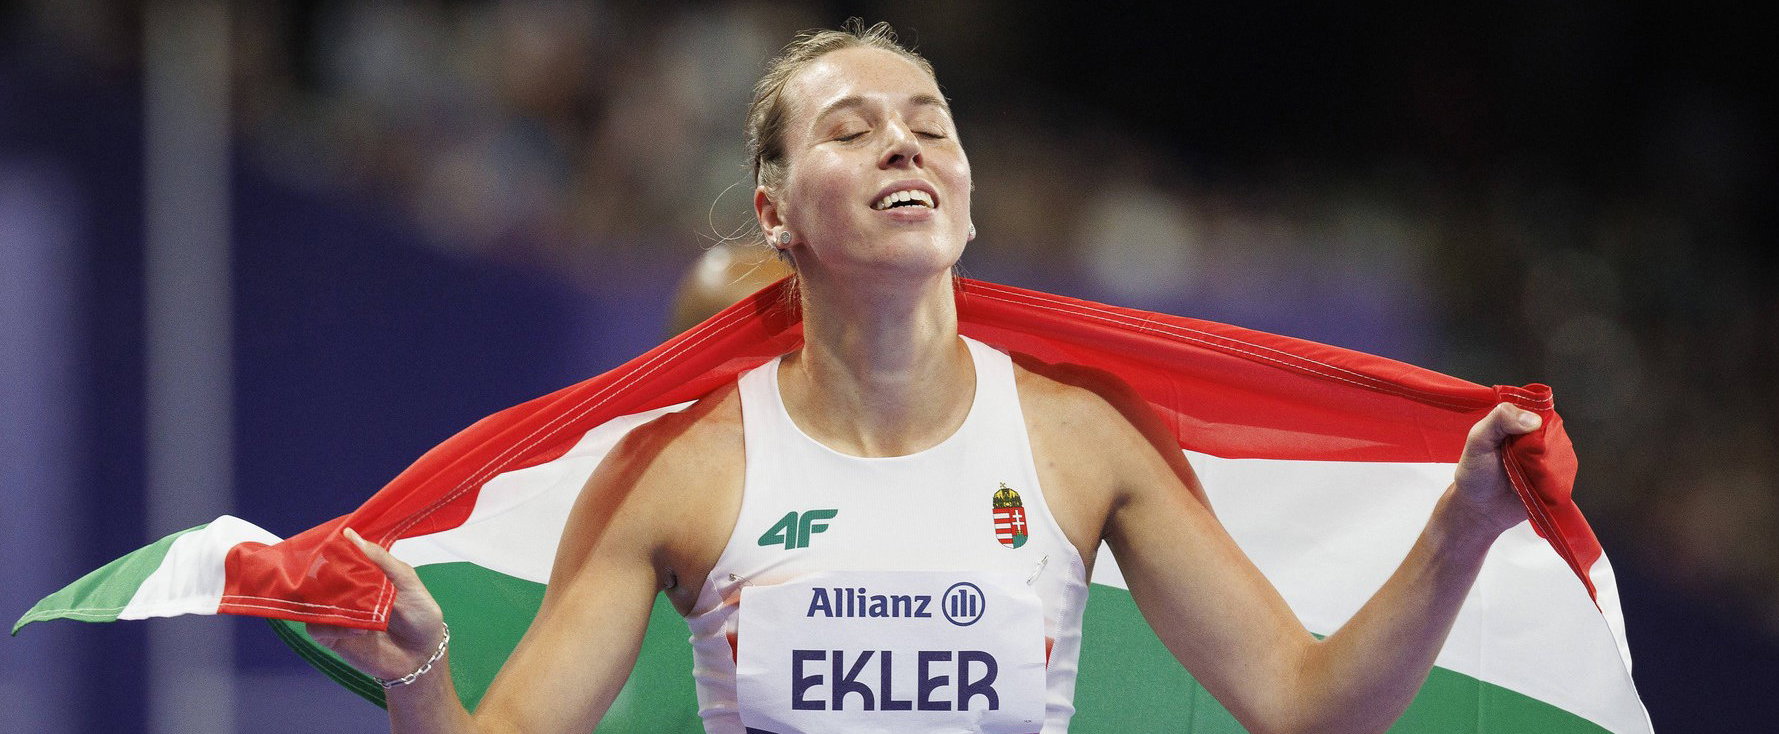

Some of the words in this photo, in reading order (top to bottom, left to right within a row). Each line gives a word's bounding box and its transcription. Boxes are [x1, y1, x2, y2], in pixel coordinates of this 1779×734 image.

[757, 508, 838, 550] 4F
[806, 587, 932, 618] Allianz
[791, 649, 1000, 711] EKLER
